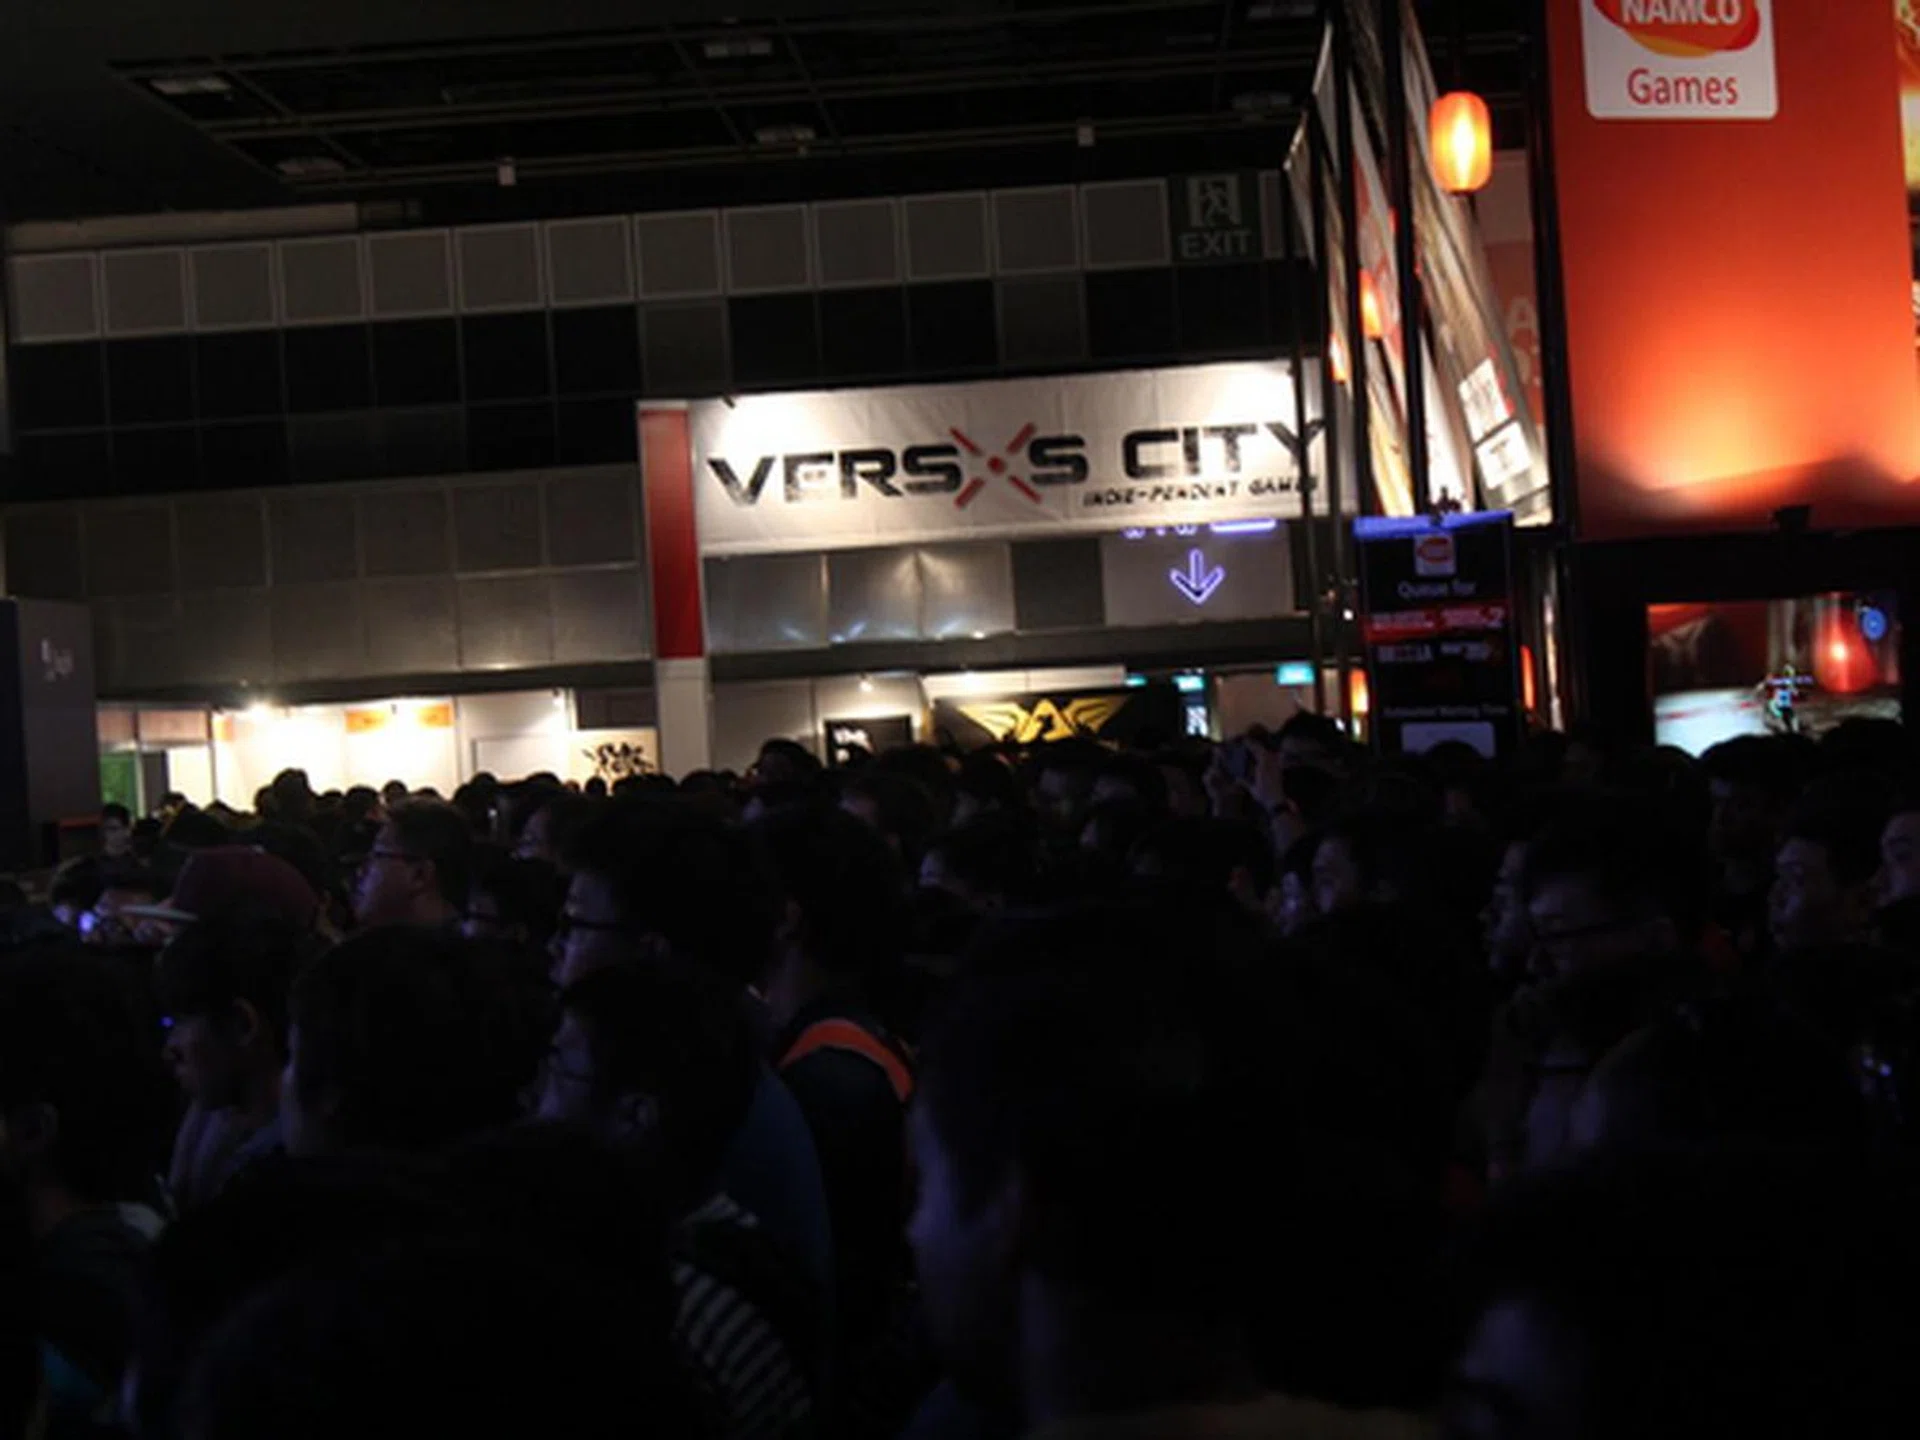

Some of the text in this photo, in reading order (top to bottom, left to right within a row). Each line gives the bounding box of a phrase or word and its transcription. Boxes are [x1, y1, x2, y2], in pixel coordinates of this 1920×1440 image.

[1620, 0, 1742, 26] NAMCO
[1627, 67, 1738, 105] Games
[1178, 229, 1252, 259] EXIT
[1122, 418, 1327, 478] CITY
